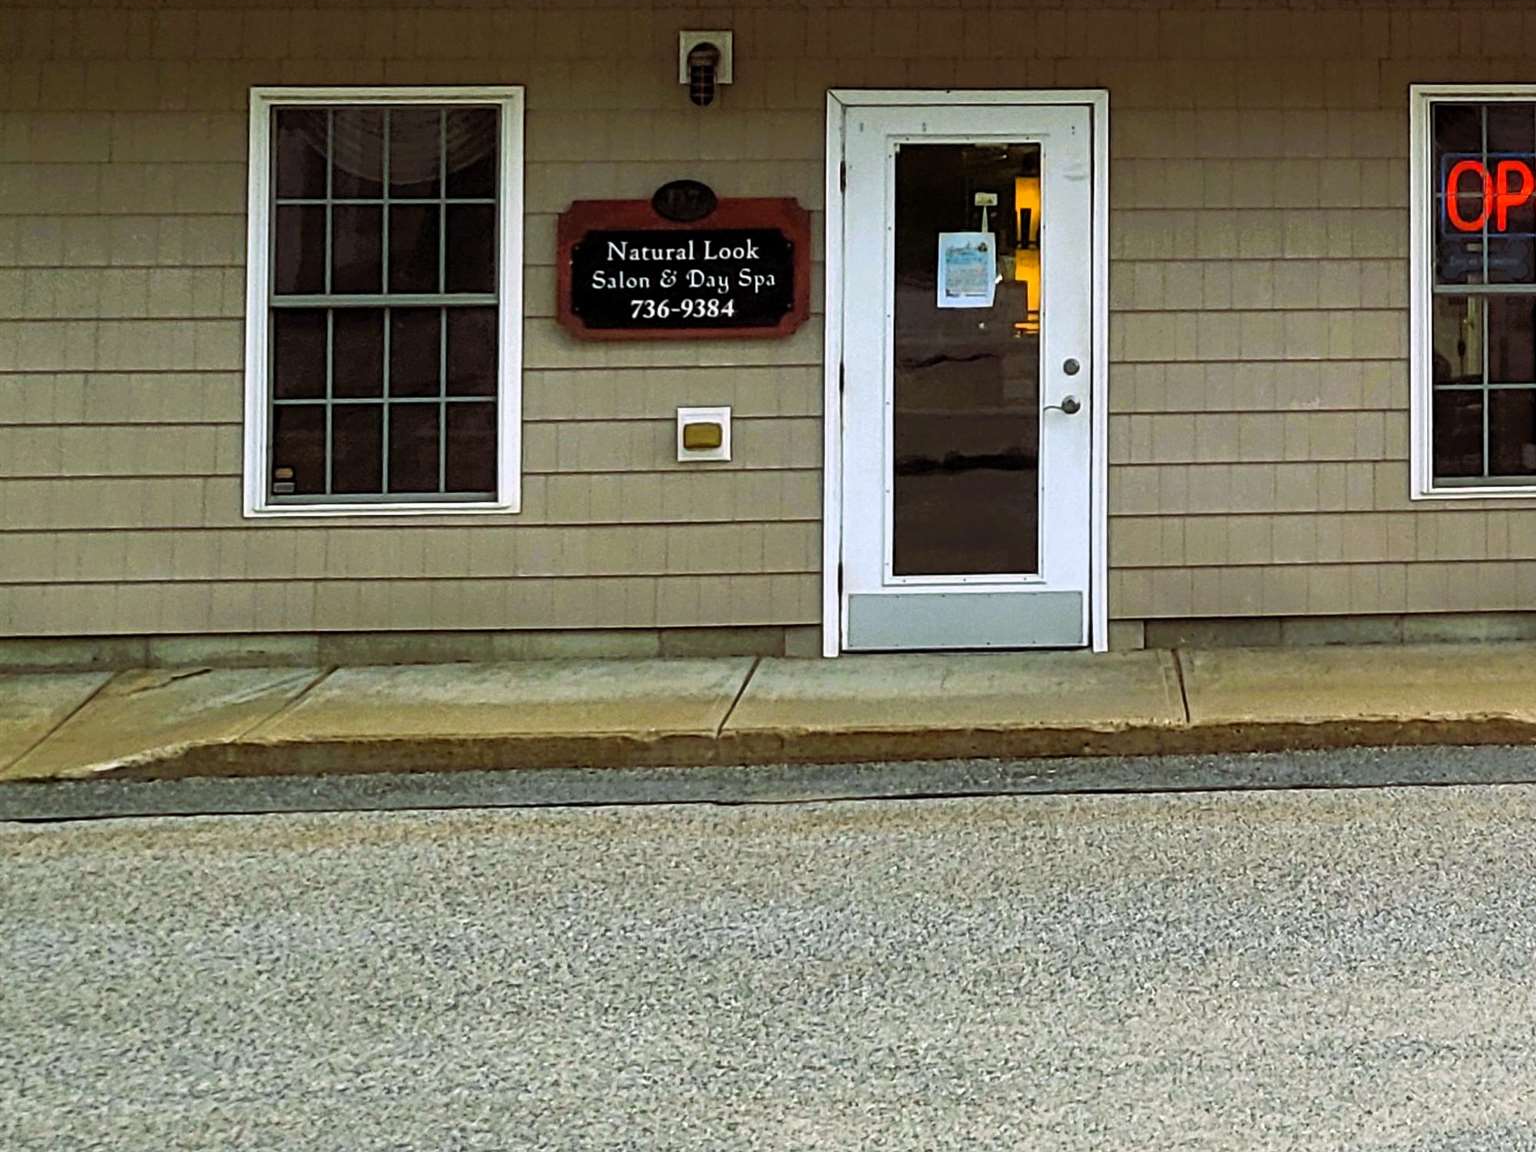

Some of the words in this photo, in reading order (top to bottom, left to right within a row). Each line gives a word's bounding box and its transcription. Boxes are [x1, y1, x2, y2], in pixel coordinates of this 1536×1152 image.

[607, 240, 694, 262] Natural
[703, 239, 760, 260] Look
[591, 270, 650, 290] Salon
[659, 269, 677, 288] &
[686, 269, 729, 294] Day
[738, 268, 776, 294] Spa
[630, 298, 735, 319] 736-9384
